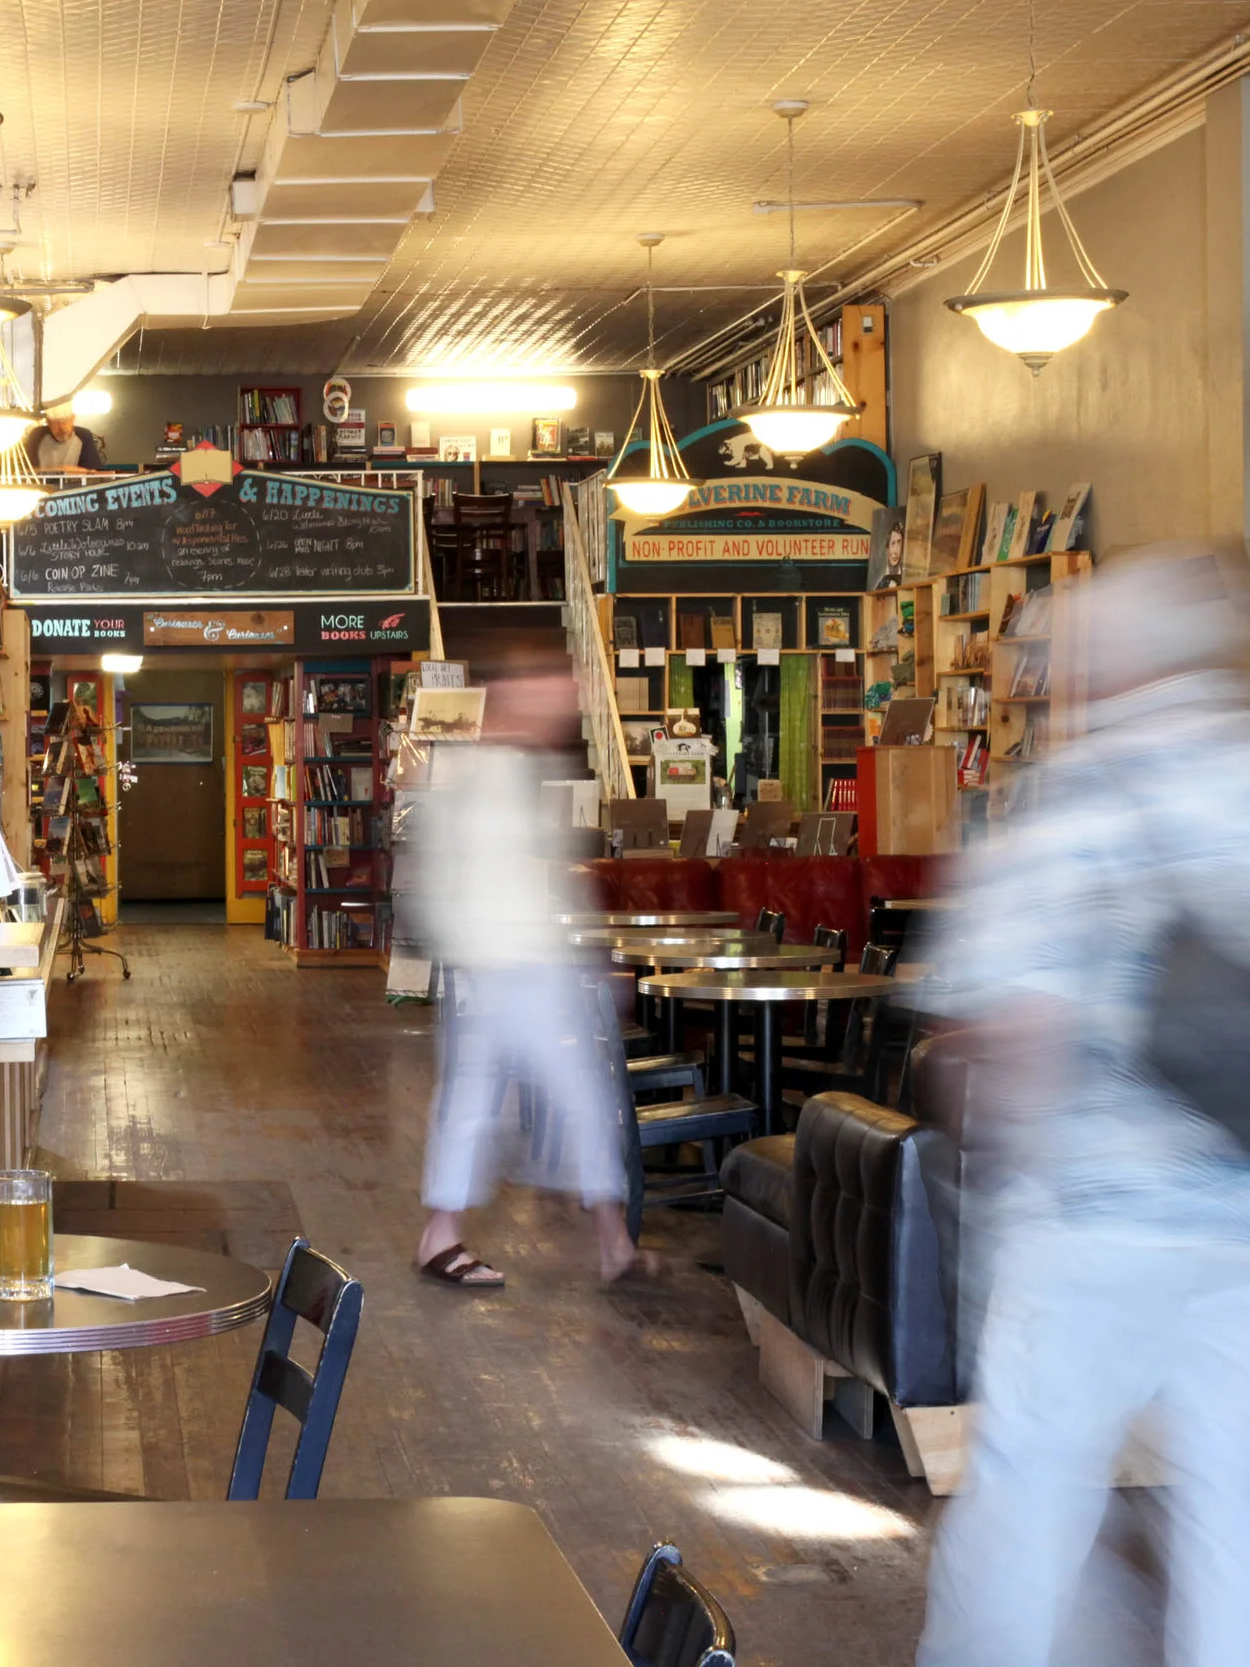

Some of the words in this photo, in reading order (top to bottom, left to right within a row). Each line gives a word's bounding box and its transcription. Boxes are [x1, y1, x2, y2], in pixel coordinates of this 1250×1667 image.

[34, 494, 99, 519] COMING
[105, 477, 178, 511] EVENTS
[239, 478, 258, 503] &
[266, 480, 400, 514] HAPPENINGS
[687, 483, 782, 510] LVERINE
[786, 484, 852, 517] FARM
[262, 509, 288, 521] 6/20
[44, 520, 78, 535] POETRY
[81, 517, 109, 532] SLAM
[116, 518, 134, 531] 8pm
[662, 519, 734, 529] PUBLISHING
[737, 519, 756, 528] CO.
[758, 518, 766, 528] &
[768, 518, 842, 528] BOOKSTORE
[18, 545, 37, 557] 6/6
[178, 547, 189, 556] an
[190, 546, 219, 556] evening
[221, 544, 230, 552] of
[314, 539, 339, 552] NIGHT
[346, 537, 364, 550] 8pm
[722, 538, 750, 557] AND
[755, 538, 836, 557] VOLUNTEER
[841, 538, 870, 556] RUN
[50, 549, 81, 562] STORY
[20, 570, 39, 583] 6/6
[91, 563, 120, 578] ZINE
[198, 570, 223, 583] 7pm
[269, 566, 290, 578] 6/28
[296, 565, 317, 577] letter
[320, 565, 352, 581] writing
[353, 564, 373, 576] club
[31, 619, 91, 637] DONATE
[93, 619, 125, 629] YOUR
[321, 615, 365, 629] MORE
[203, 620, 226, 641] &
[321, 630, 366, 640] BOOKS
[370, 630, 409, 640] UPSTAIRS
